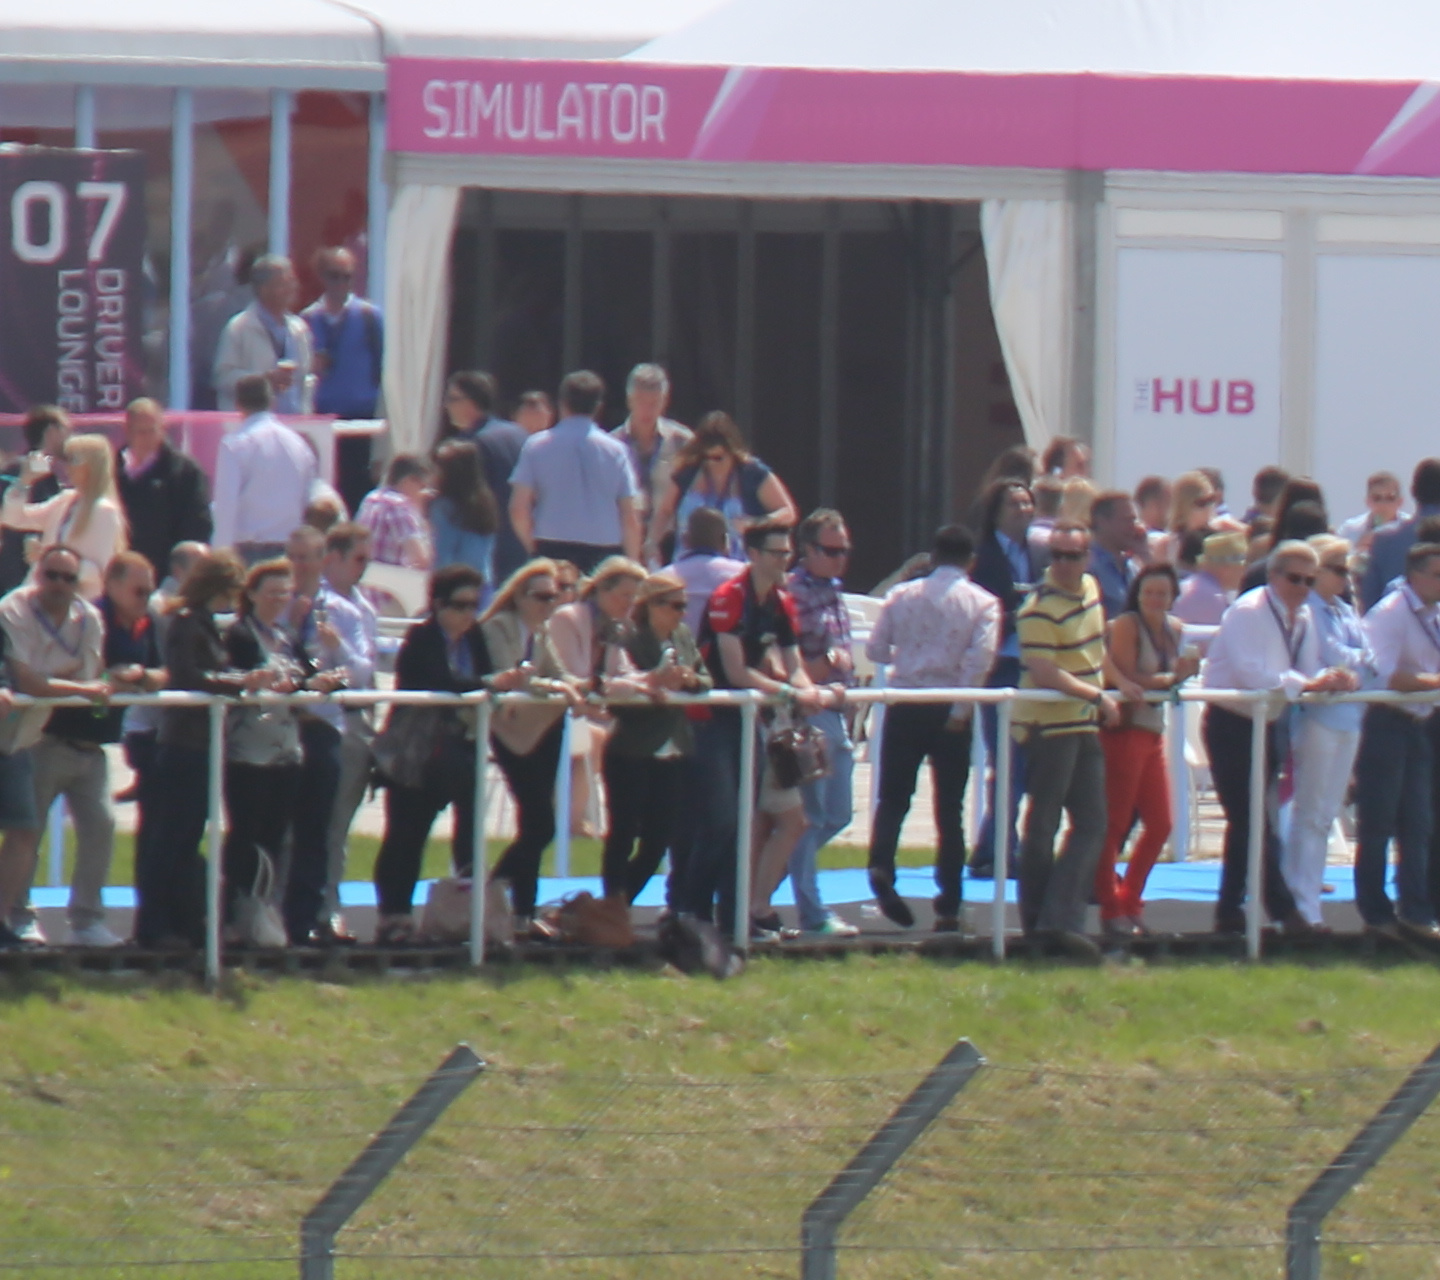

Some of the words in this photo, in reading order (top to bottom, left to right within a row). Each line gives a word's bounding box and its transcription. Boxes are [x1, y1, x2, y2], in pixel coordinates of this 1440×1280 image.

[422, 79, 668, 142] SIMULATOR
[12, 180, 128, 264] 07
[56, 268, 88, 414] LOUNGE
[95, 268, 126, 408] DRIVER
[1152, 376, 1256, 415] HUB
